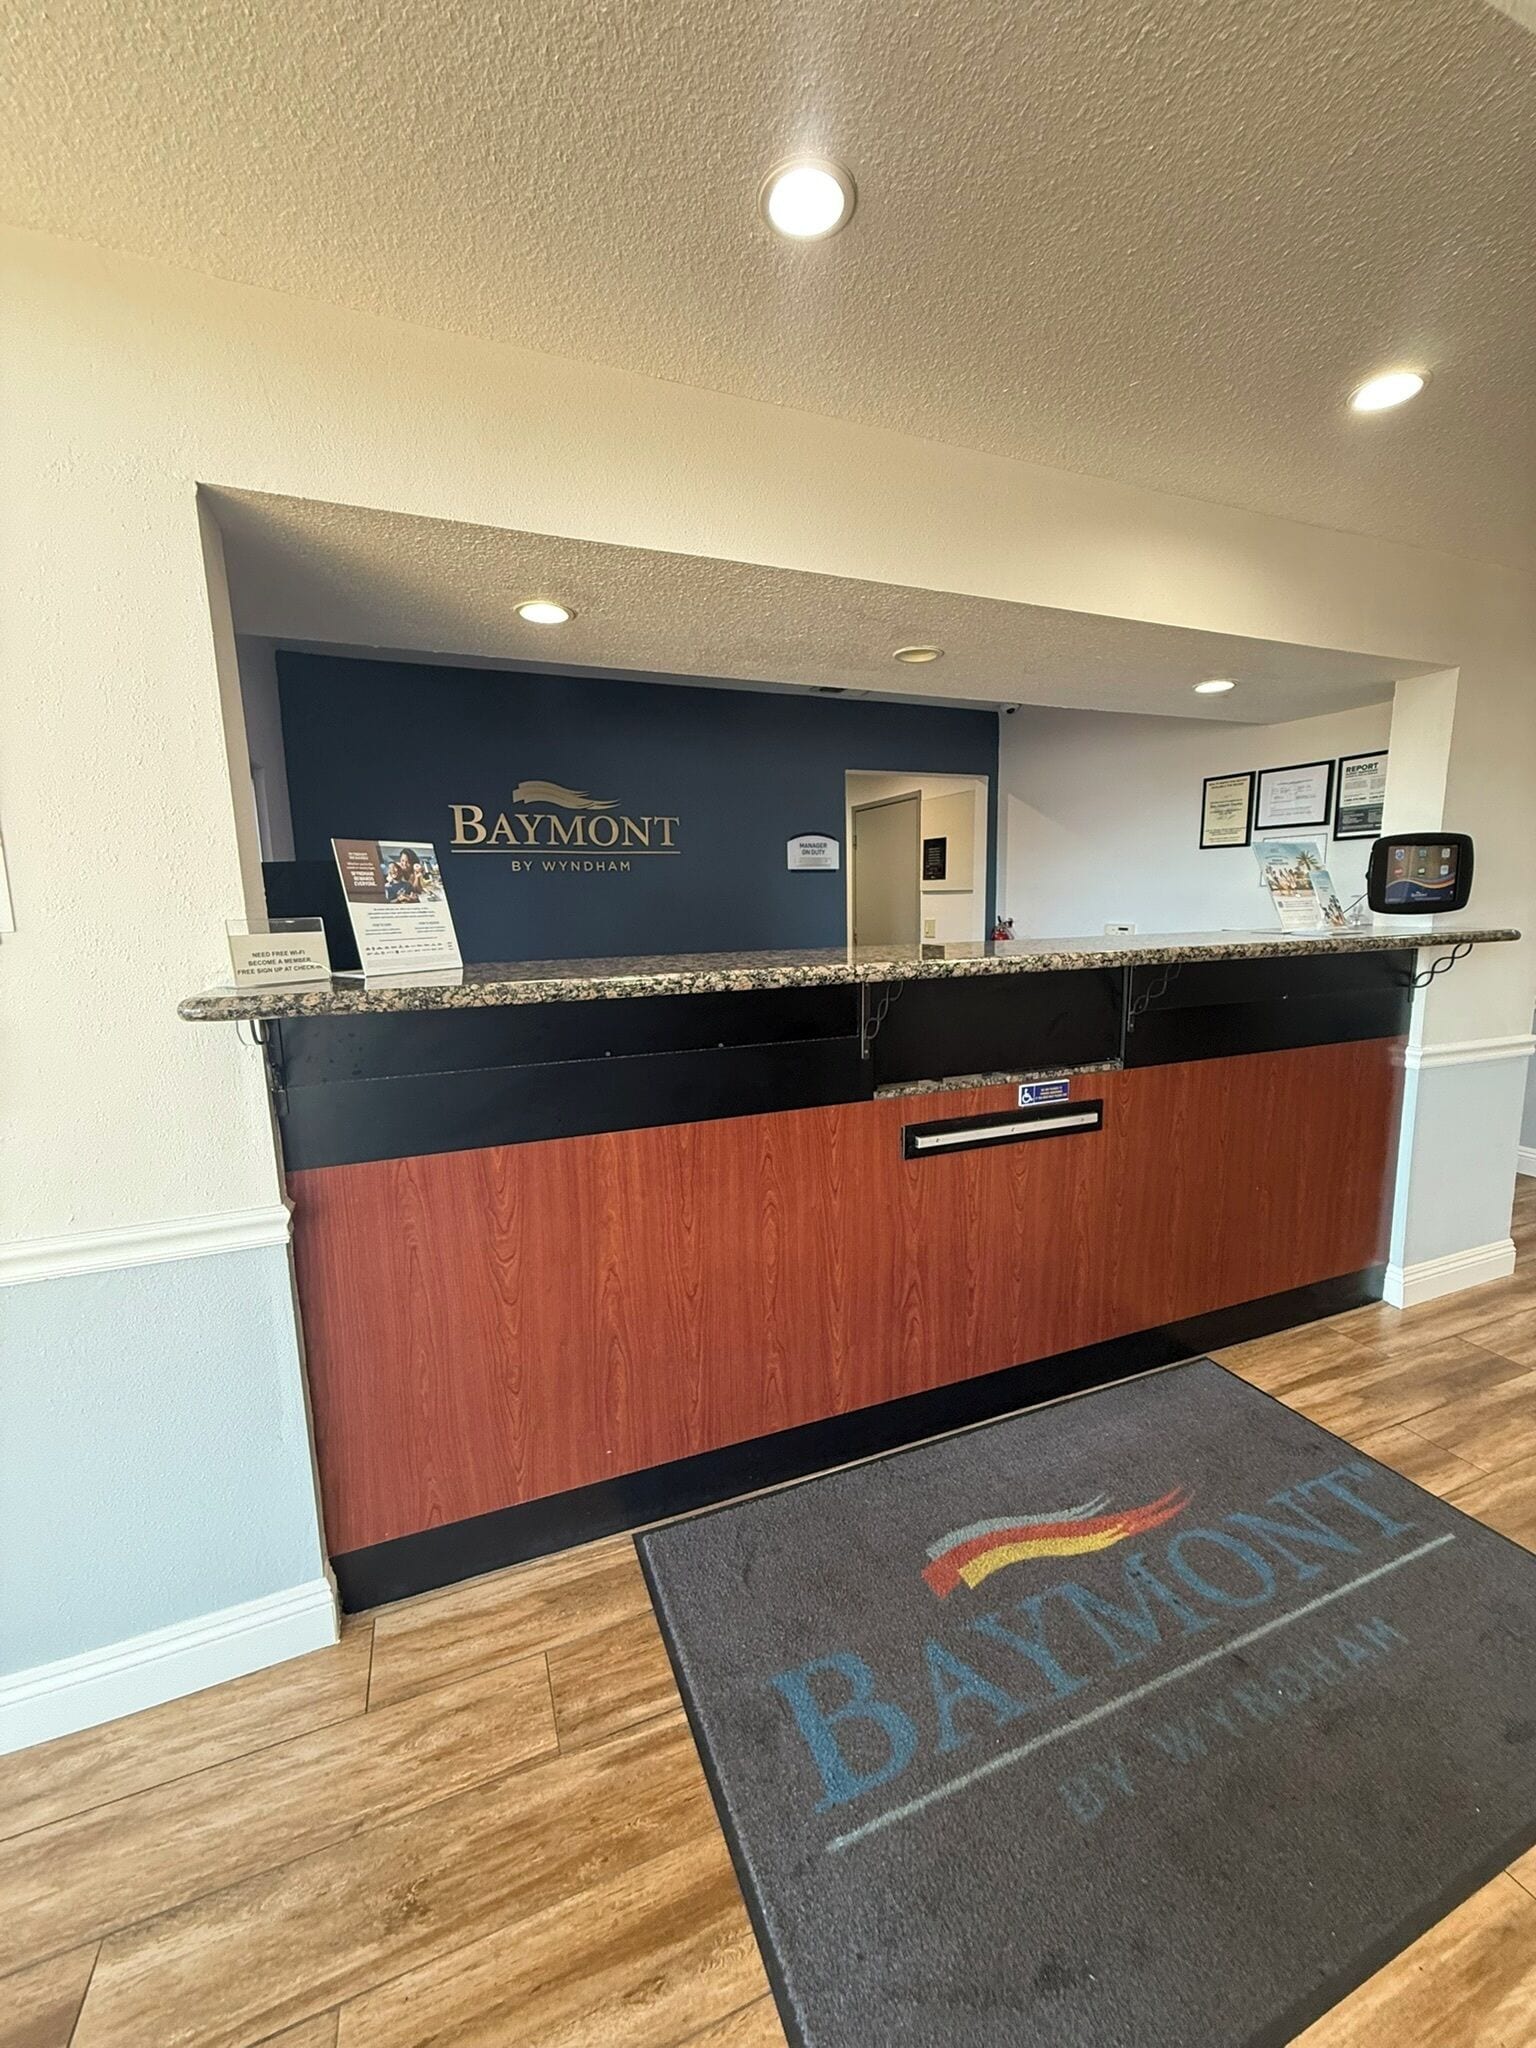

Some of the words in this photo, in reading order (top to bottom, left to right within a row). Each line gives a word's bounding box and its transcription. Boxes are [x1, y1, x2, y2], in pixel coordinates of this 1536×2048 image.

[1345, 762, 1379, 773] REPORT
[447, 804, 681, 847] BAYMONT
[511, 860, 534, 873] BY
[542, 860, 632, 873] WYNDHAM
[271, 950, 288, 958] FREE
[247, 959, 277, 967] BECOME
[237, 968, 256, 976] FREE
